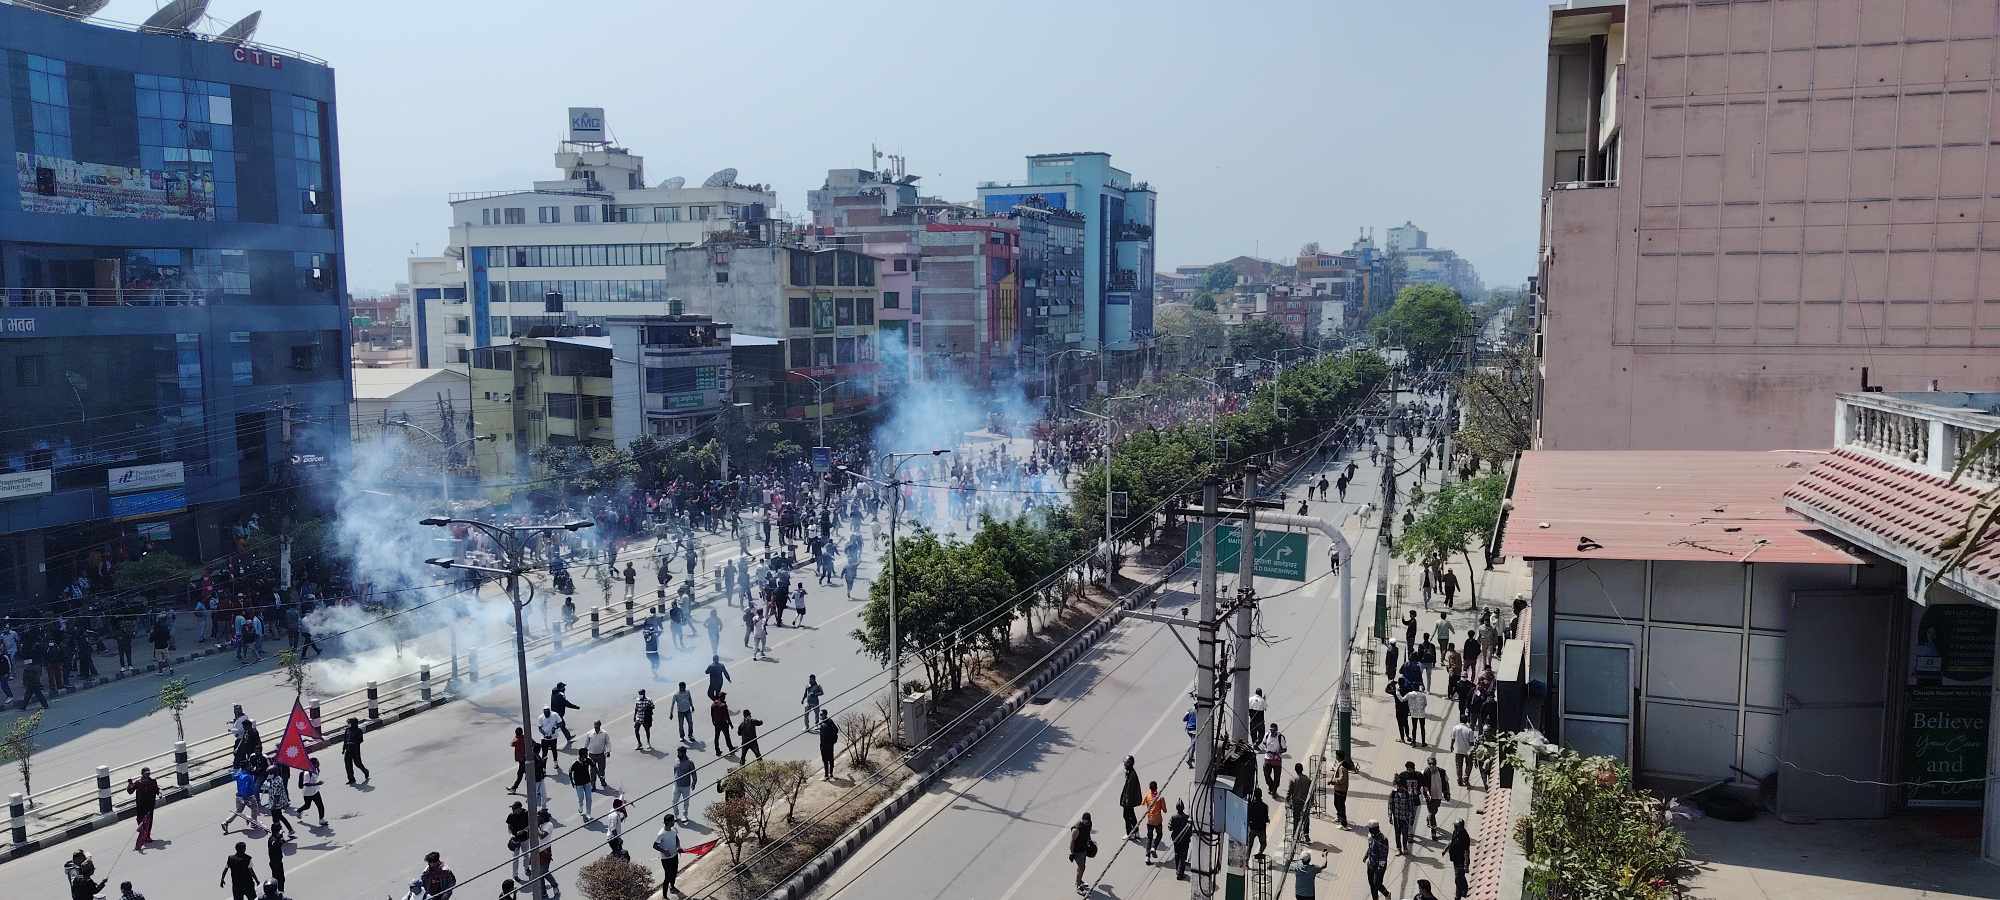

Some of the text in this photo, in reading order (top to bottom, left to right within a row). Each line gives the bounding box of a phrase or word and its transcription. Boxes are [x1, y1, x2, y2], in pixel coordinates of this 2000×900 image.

[572, 117, 601, 128] KMG
[8, 318, 36, 333] भवन
[1912, 712, 1984, 729] Believe
[1927, 754, 1965, 773] and
